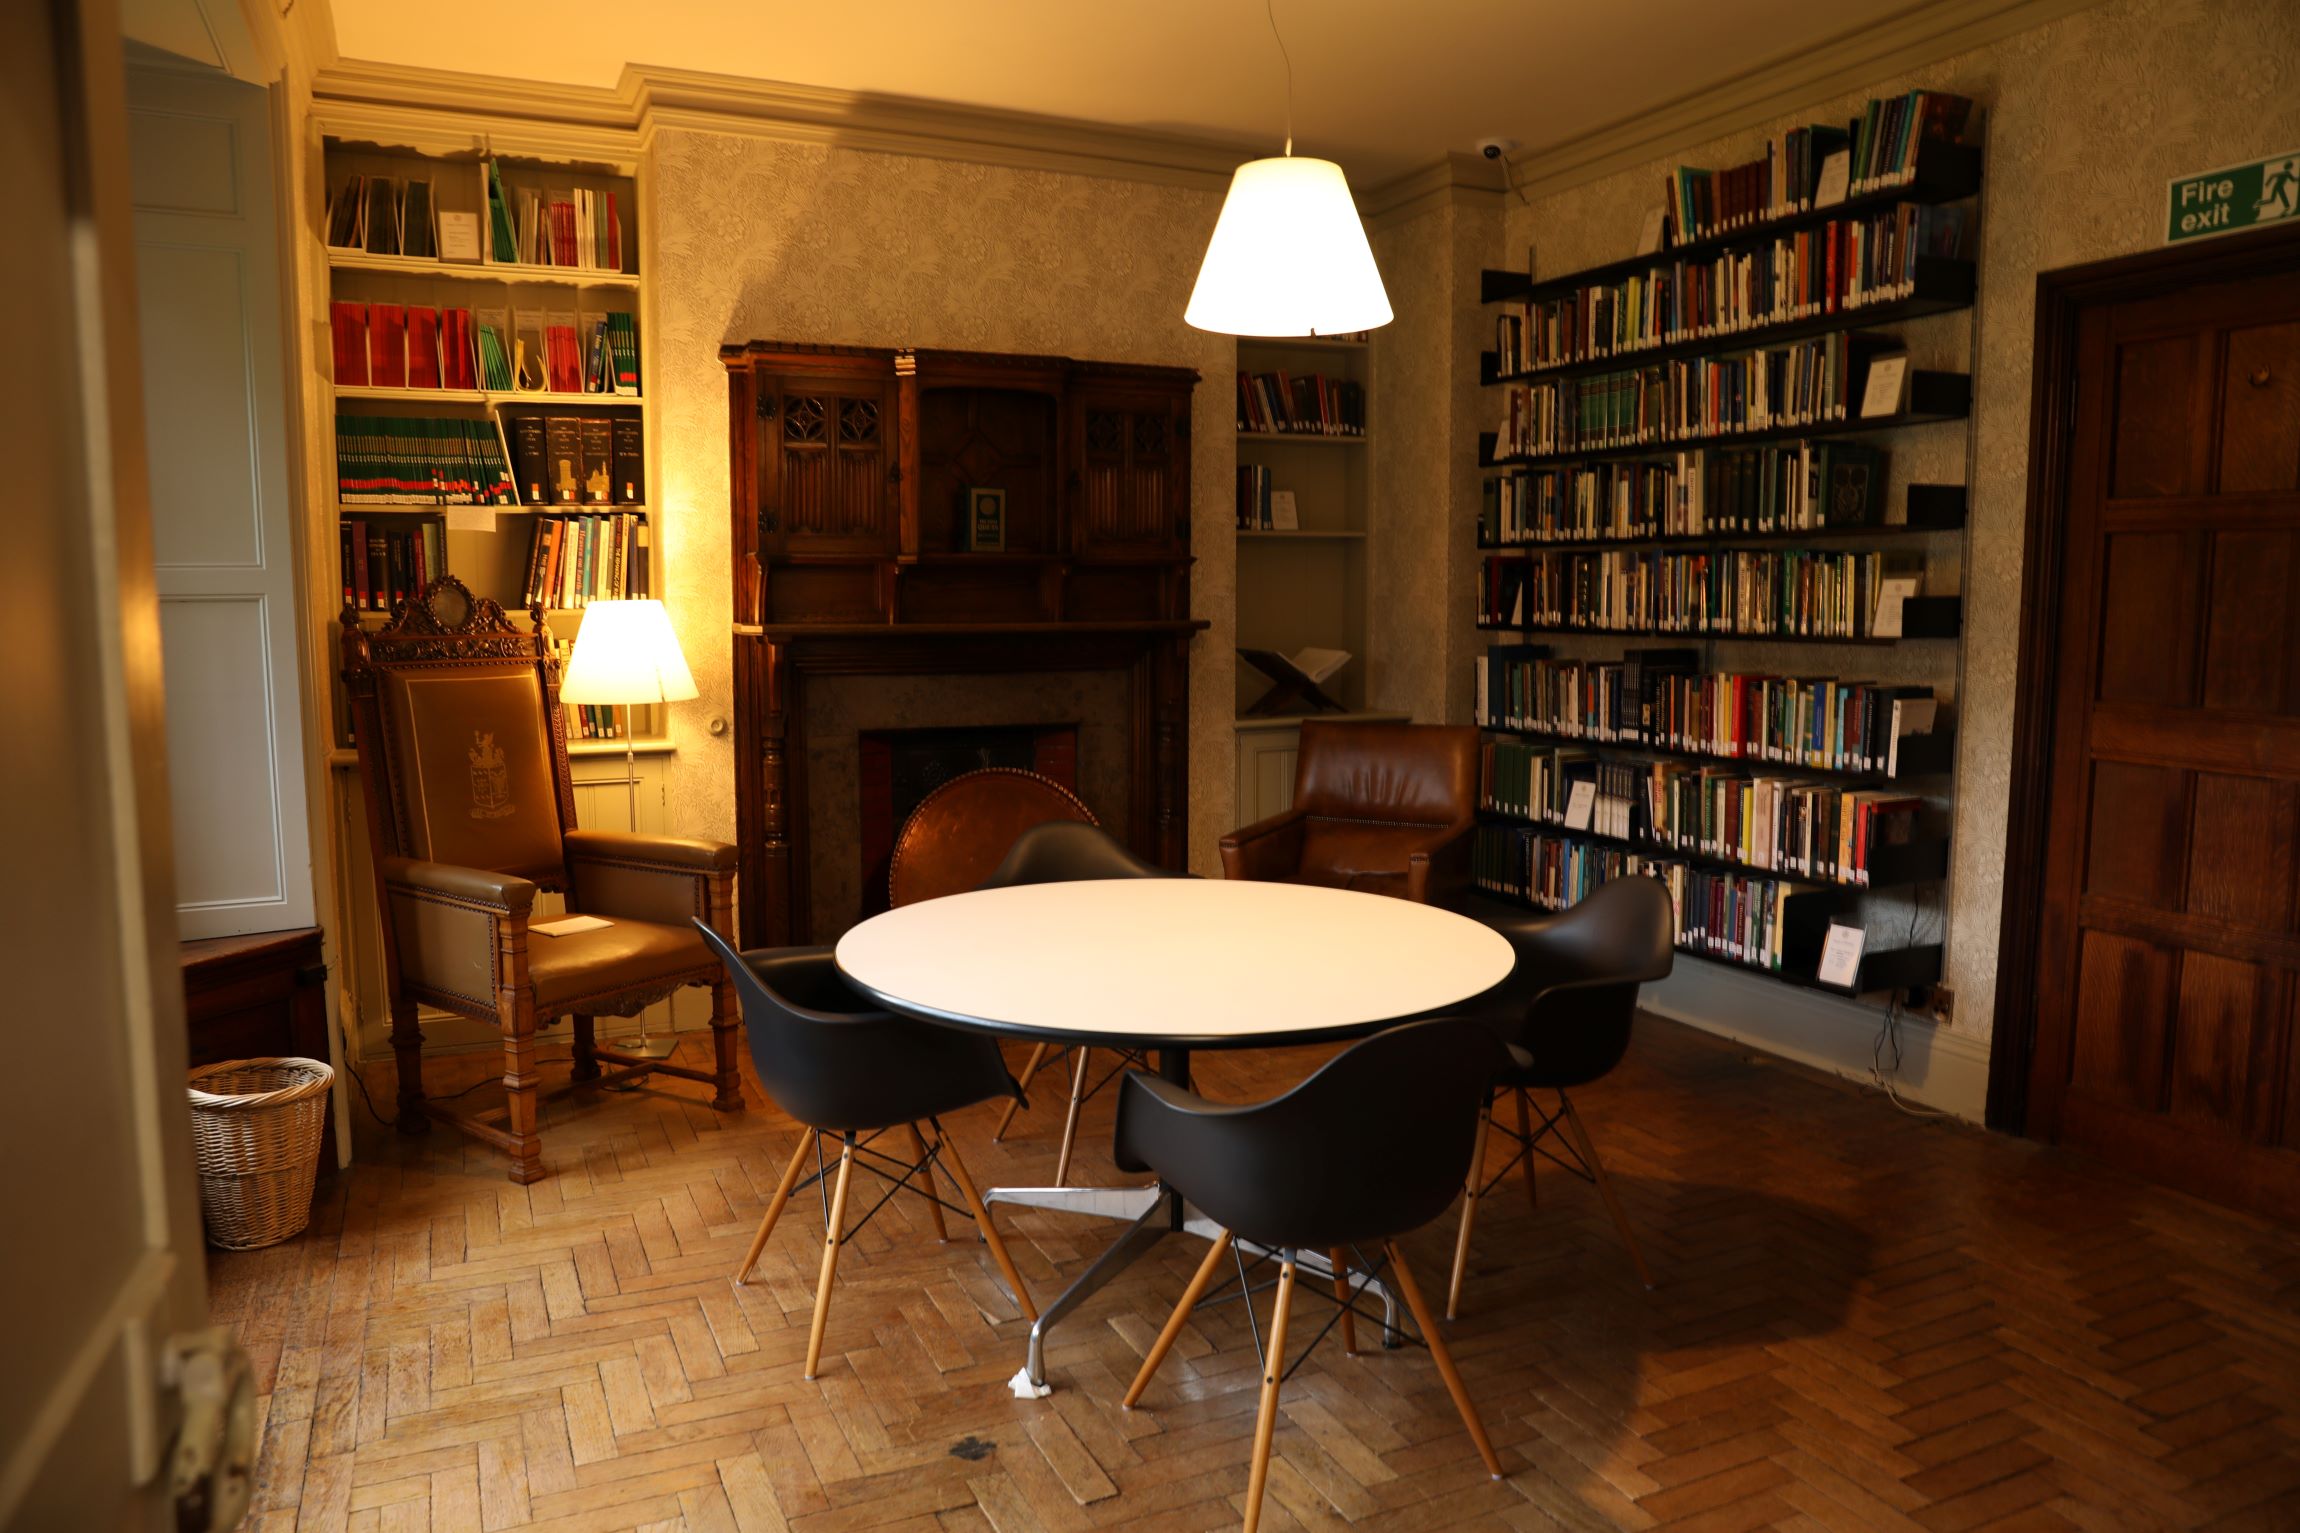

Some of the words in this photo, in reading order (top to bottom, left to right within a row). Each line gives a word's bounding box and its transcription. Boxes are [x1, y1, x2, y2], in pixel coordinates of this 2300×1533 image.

[2181, 179, 2234, 208] Fire
[2180, 202, 2231, 233] exit
[578, 530, 586, 557] Heaven
